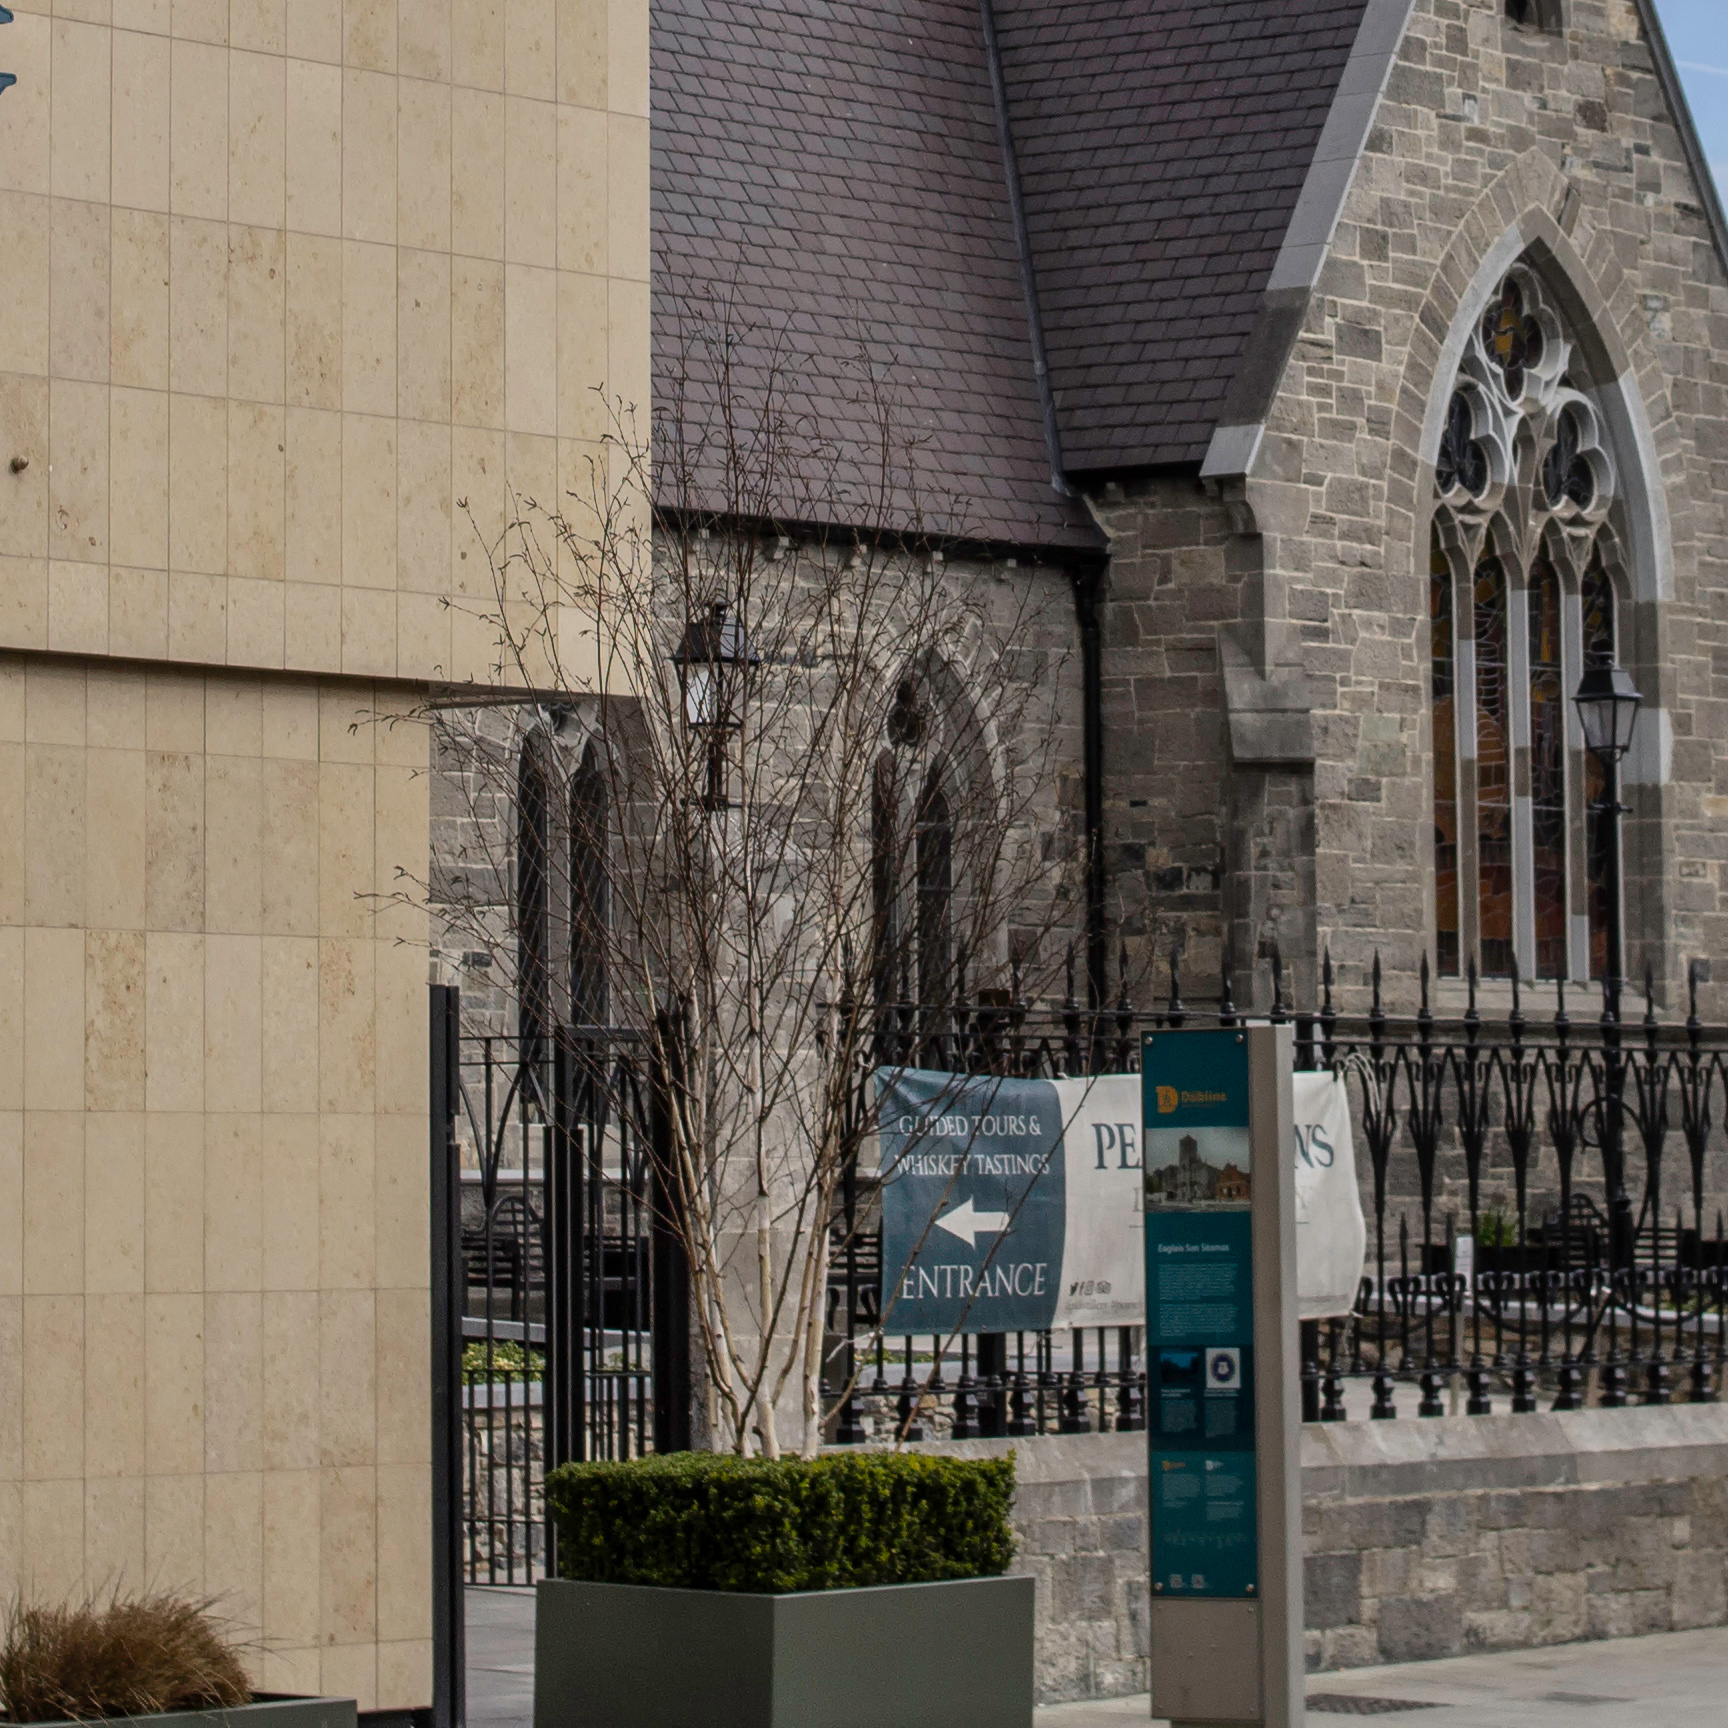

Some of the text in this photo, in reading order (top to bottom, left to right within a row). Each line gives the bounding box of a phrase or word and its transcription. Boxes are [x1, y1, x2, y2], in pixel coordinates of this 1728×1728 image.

[899, 1115, 1042, 1137] GUIDED TOURS &
[893, 1153, 1050, 1176] WHISKEY TASTINGS
[901, 1262, 1048, 1300] ENTRANCE
